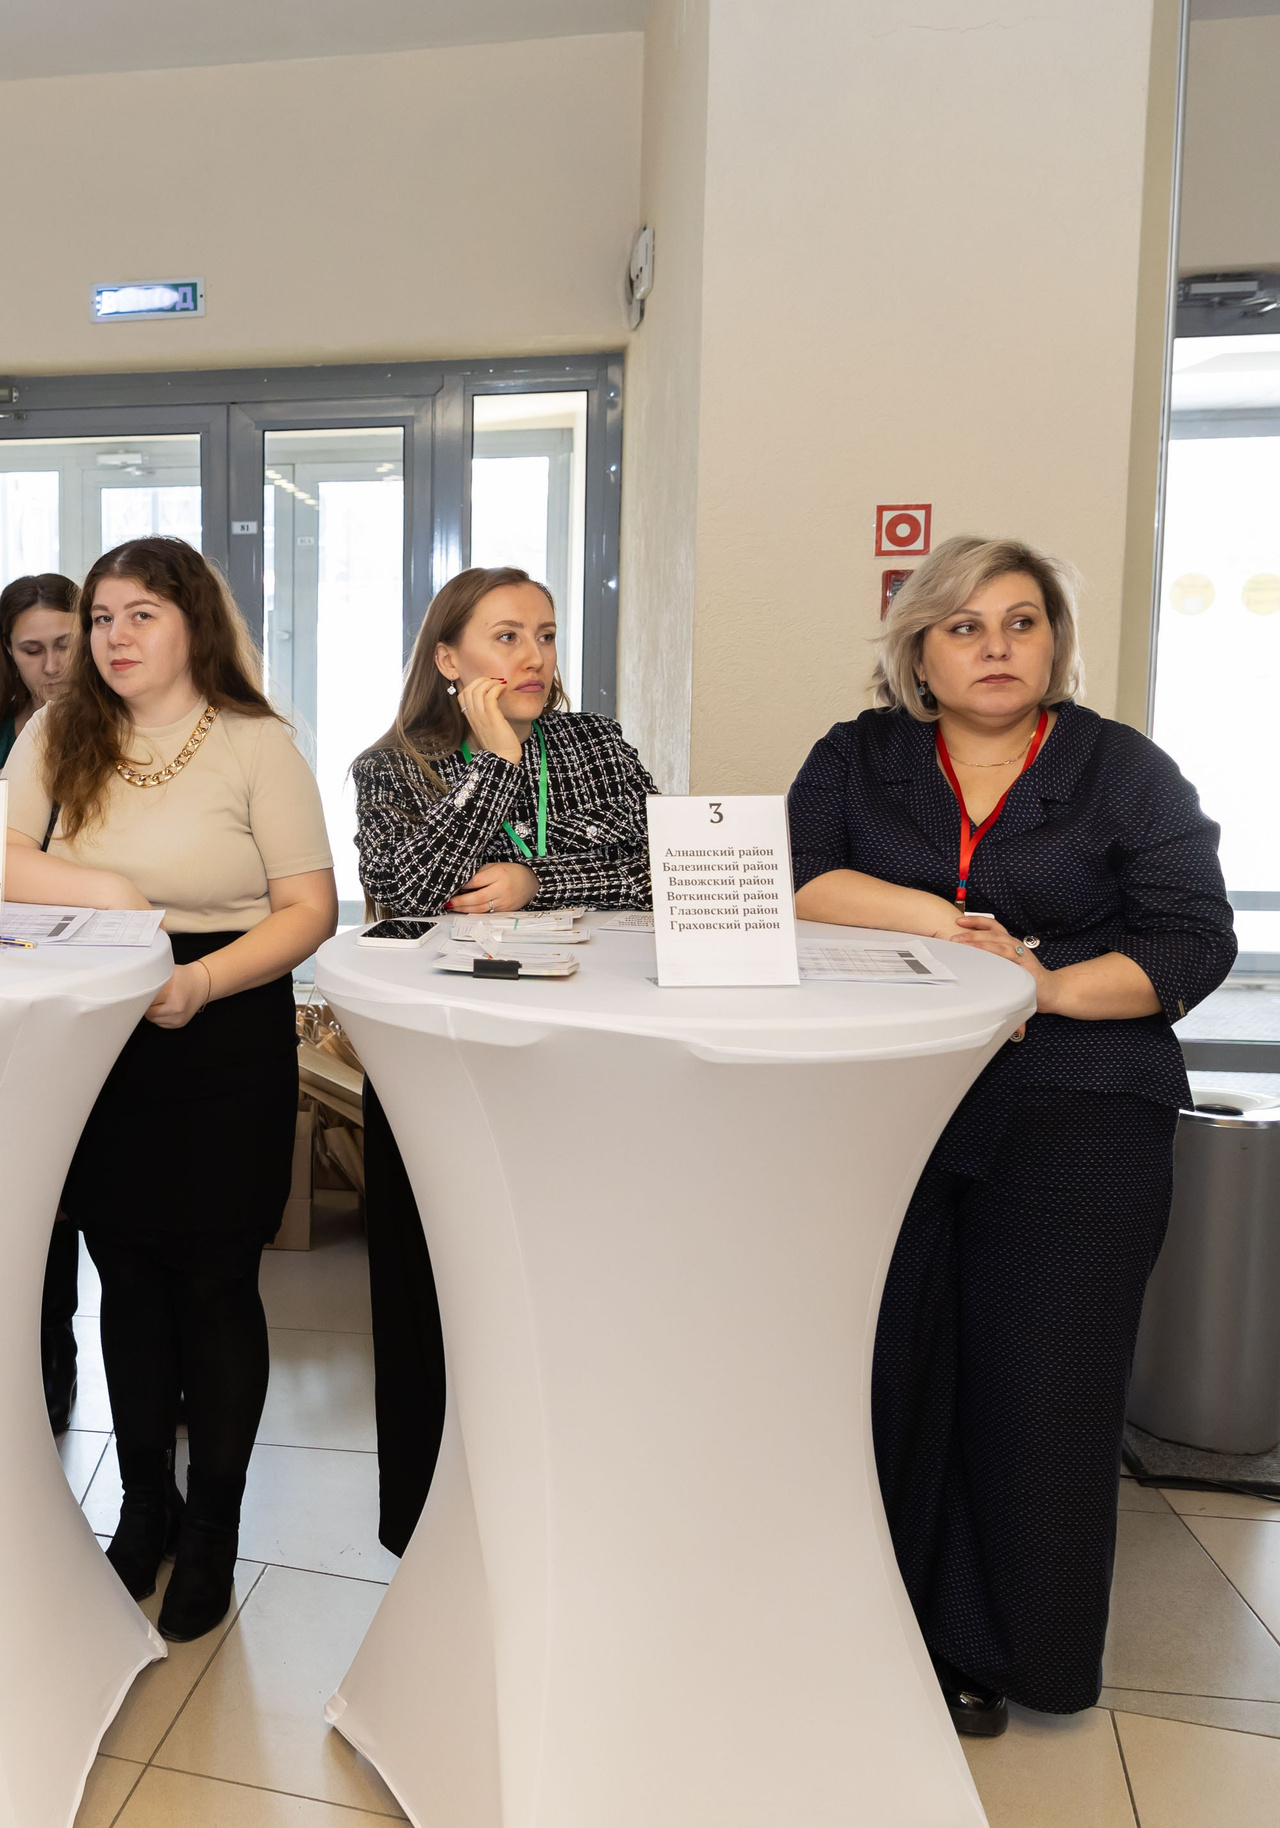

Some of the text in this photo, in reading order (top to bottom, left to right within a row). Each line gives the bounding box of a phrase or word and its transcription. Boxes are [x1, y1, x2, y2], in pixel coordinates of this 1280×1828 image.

[709, 803, 723, 823] 3
[665, 847, 773, 858] Алнашский район
[663, 861, 778, 873] Балезинский район
[669, 876, 774, 887] Вавожский район
[667, 890, 778, 902] Воткинский район
[670, 905, 778, 917] Глазовский район
[671, 920, 780, 932] Граховский район
